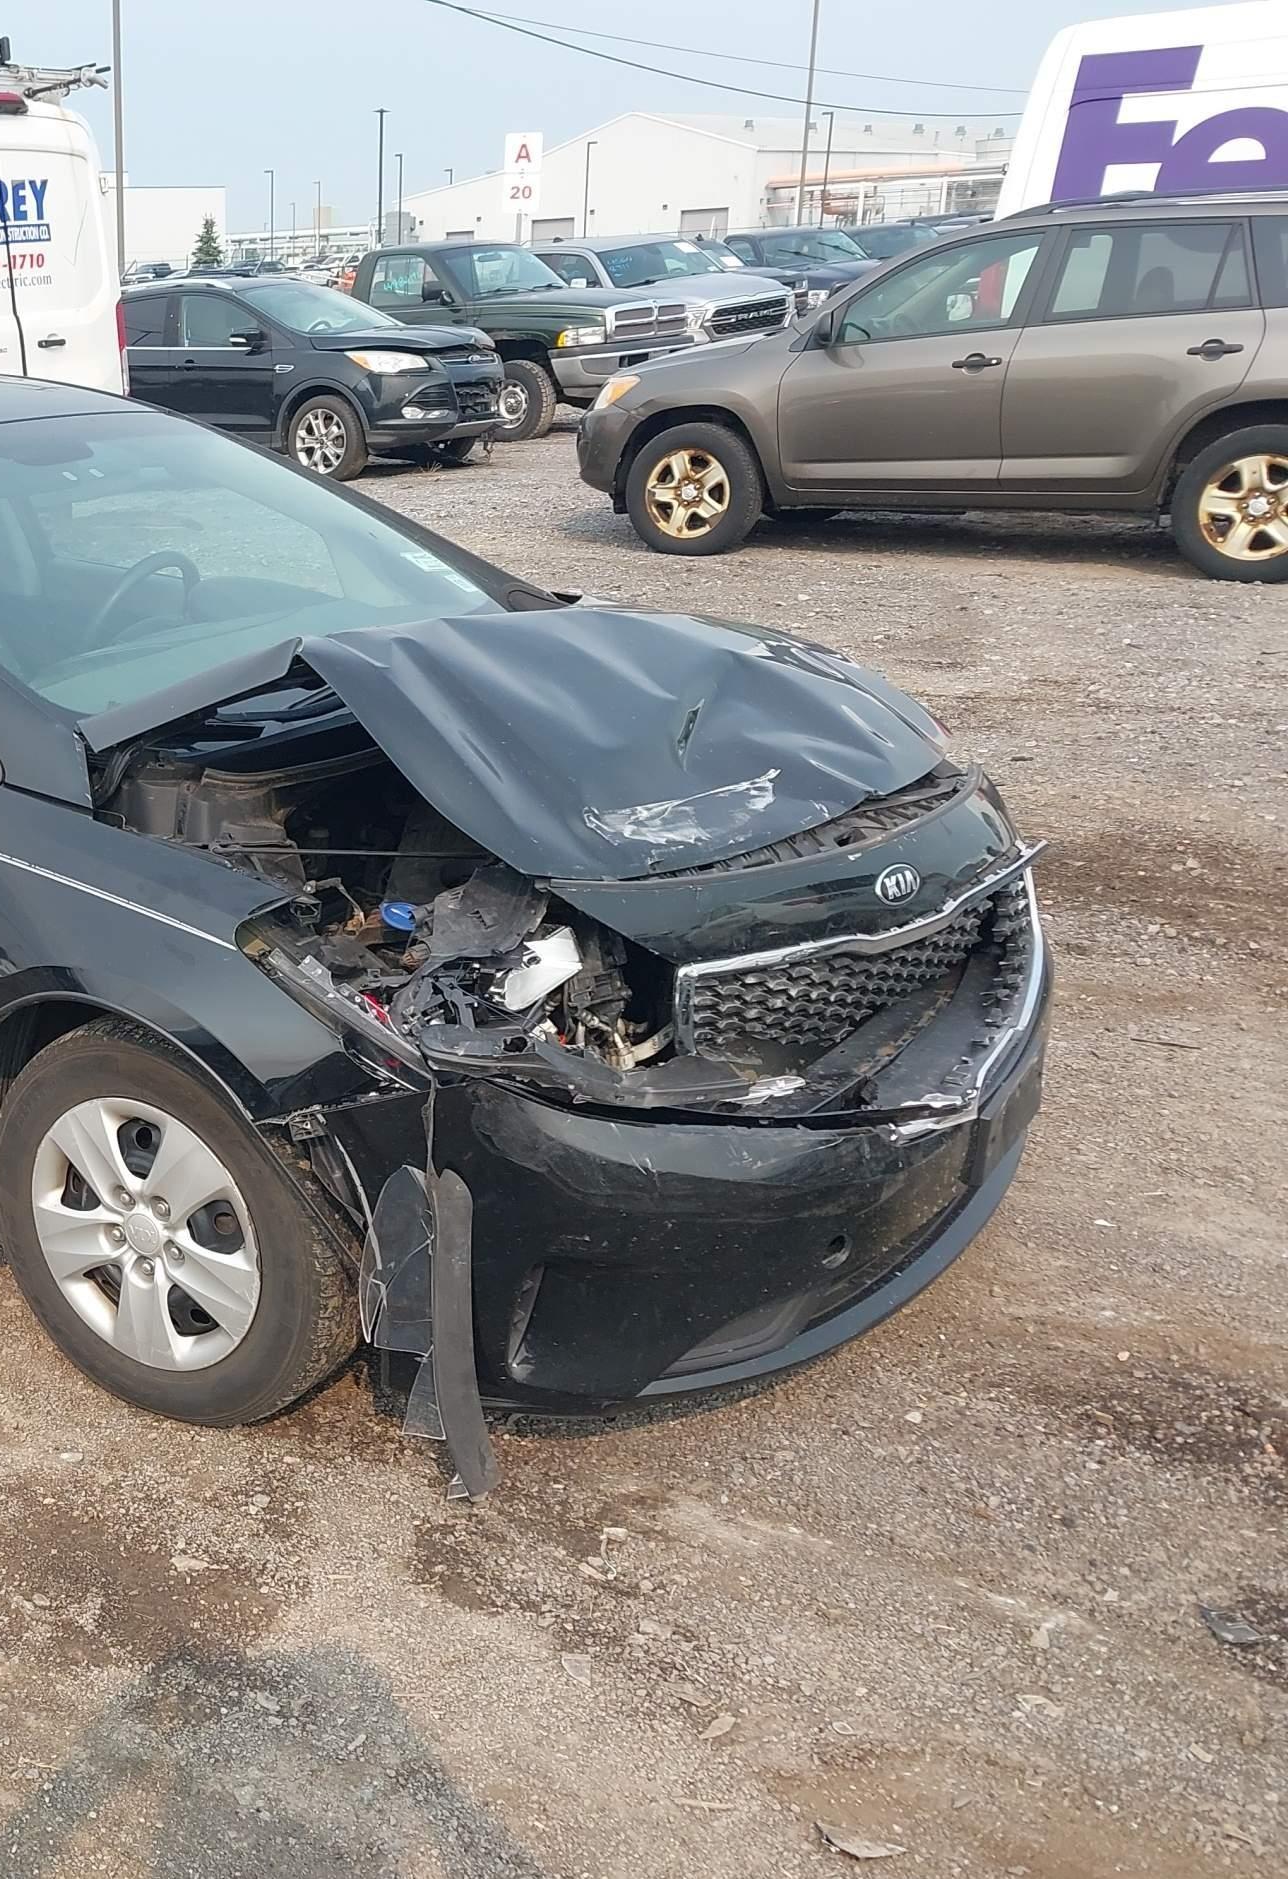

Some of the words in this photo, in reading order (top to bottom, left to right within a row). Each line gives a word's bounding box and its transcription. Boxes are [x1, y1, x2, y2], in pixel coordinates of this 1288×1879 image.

[514, 143, 532, 163] A
[509, 185, 532, 200] 20
[737, 310, 772, 321] RAM
[883, 870, 918, 901] KIA
